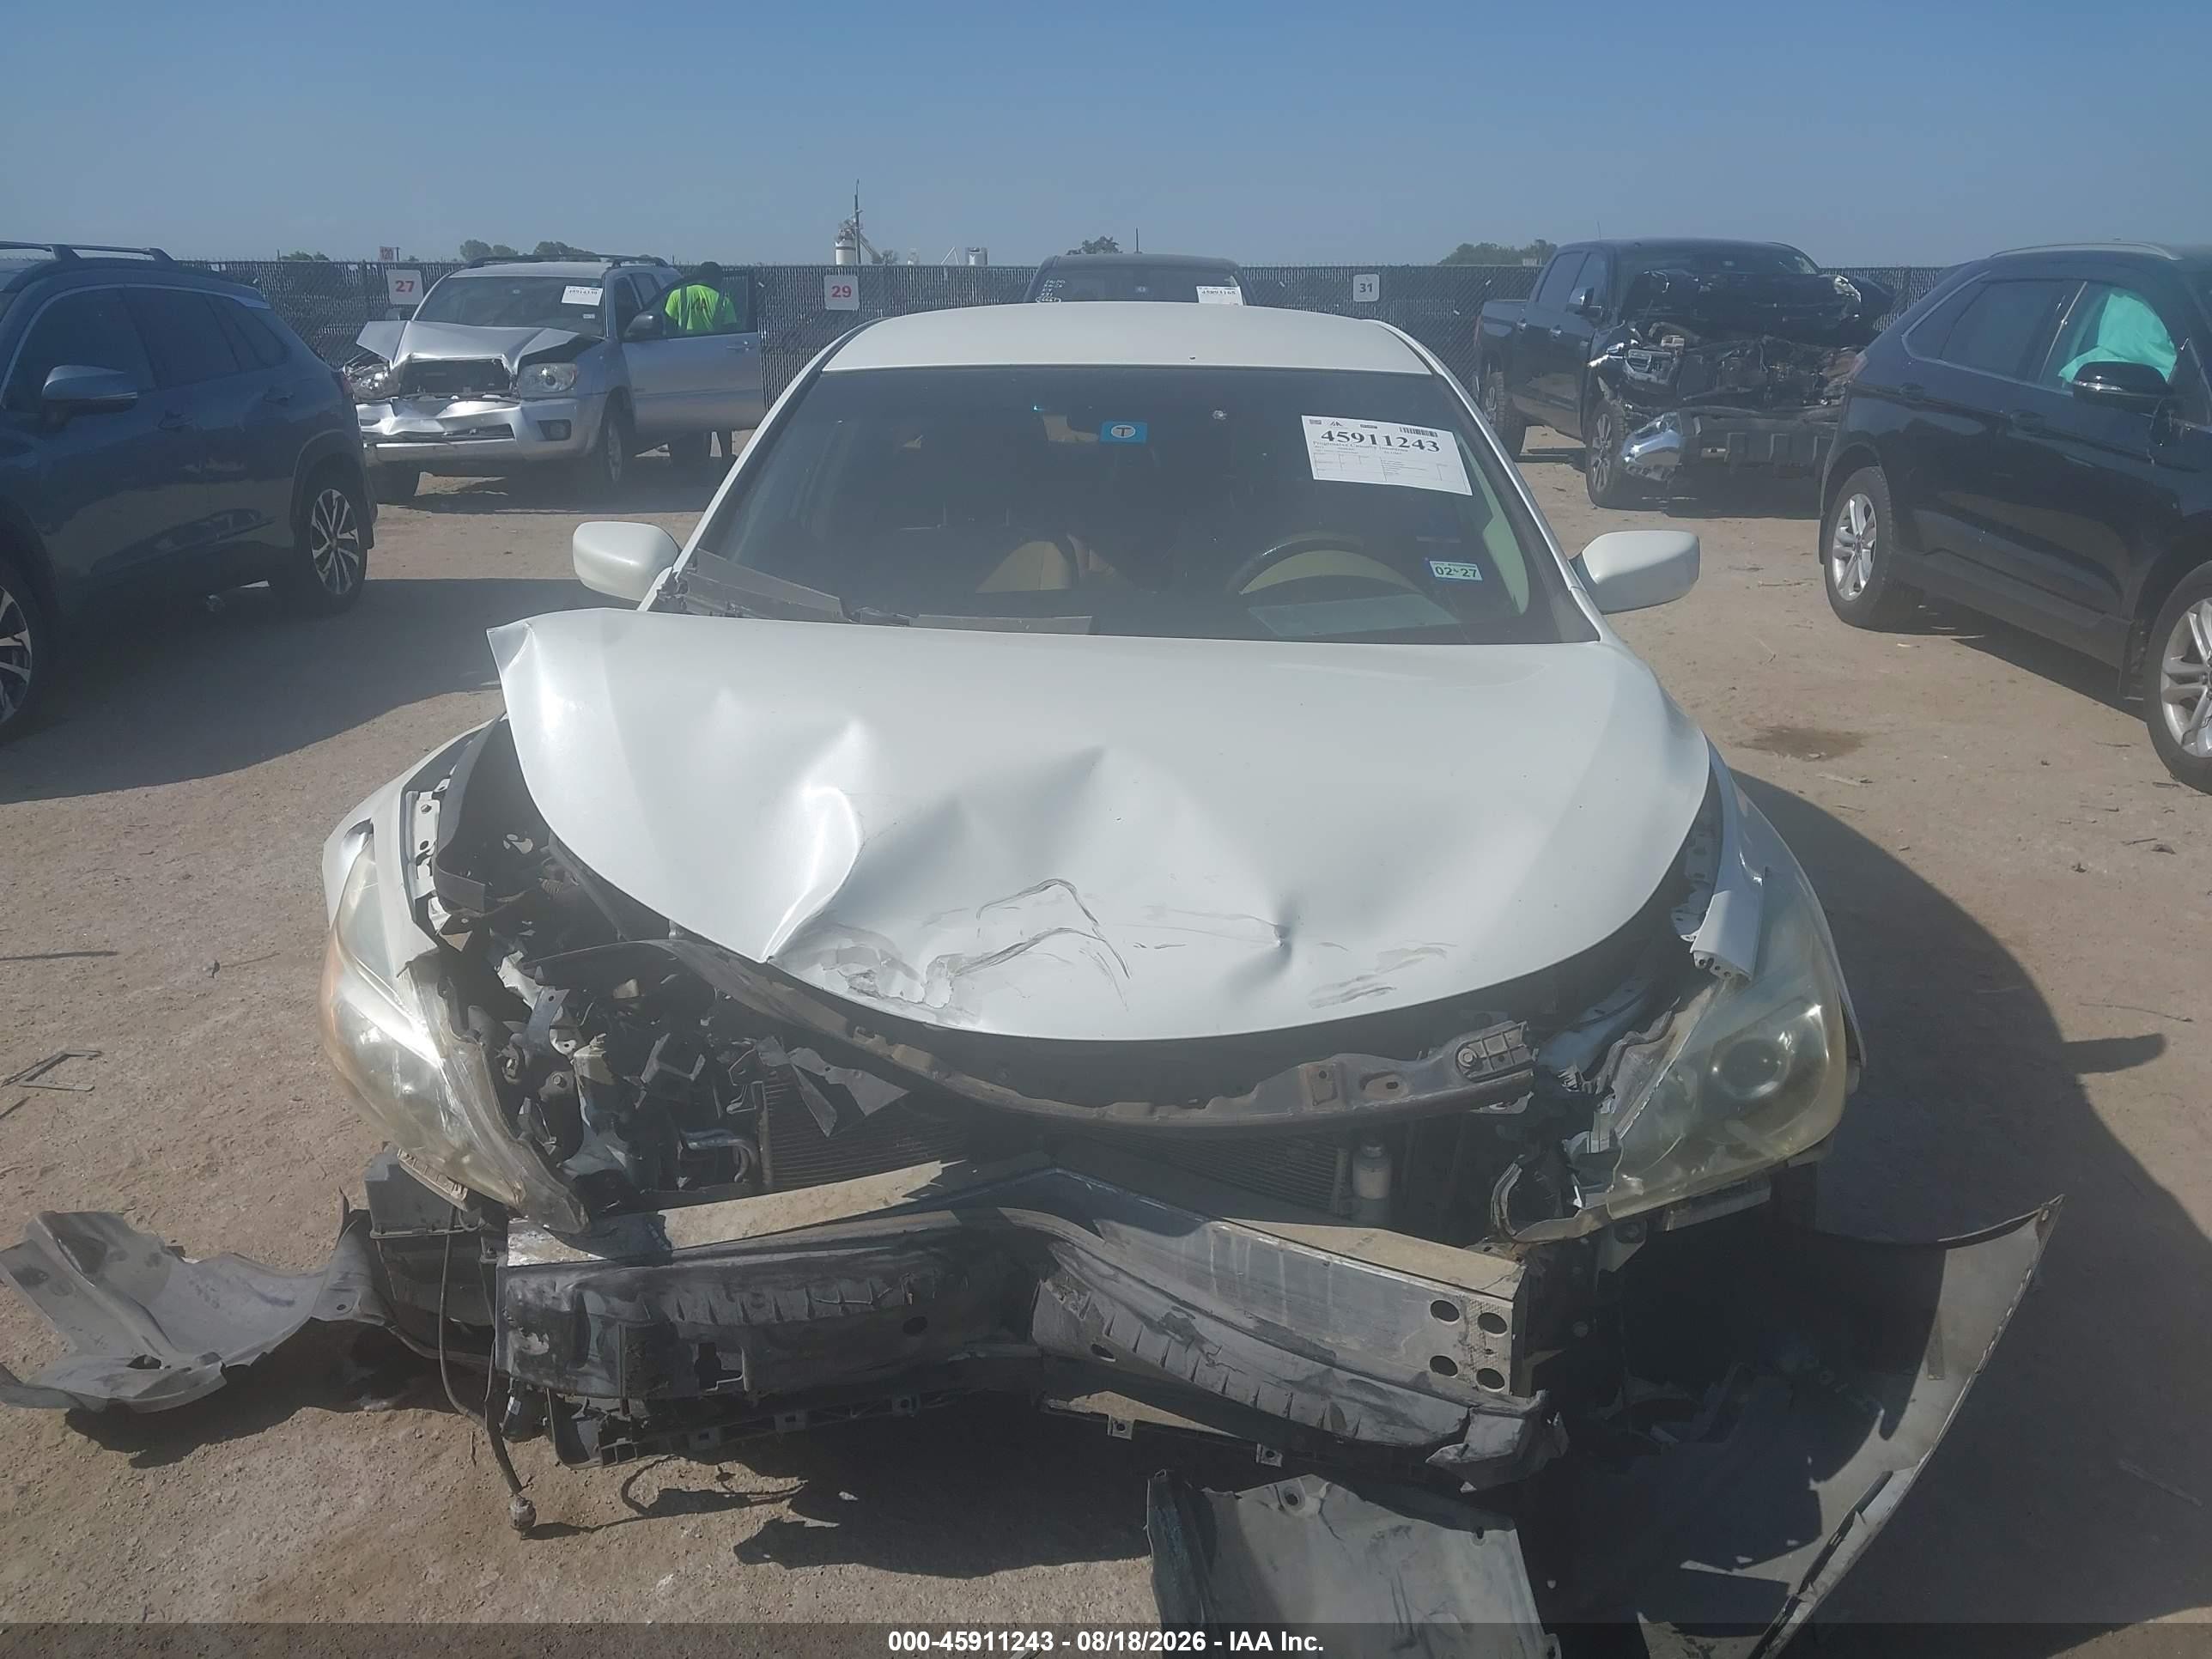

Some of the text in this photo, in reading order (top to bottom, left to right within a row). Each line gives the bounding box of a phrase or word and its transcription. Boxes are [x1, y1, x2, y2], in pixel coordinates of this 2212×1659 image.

[396, 280, 414, 292] 27
[831, 285, 852, 298] 29
[1359, 283, 1373, 293] 31
[1321, 429, 1441, 453] 45911243
